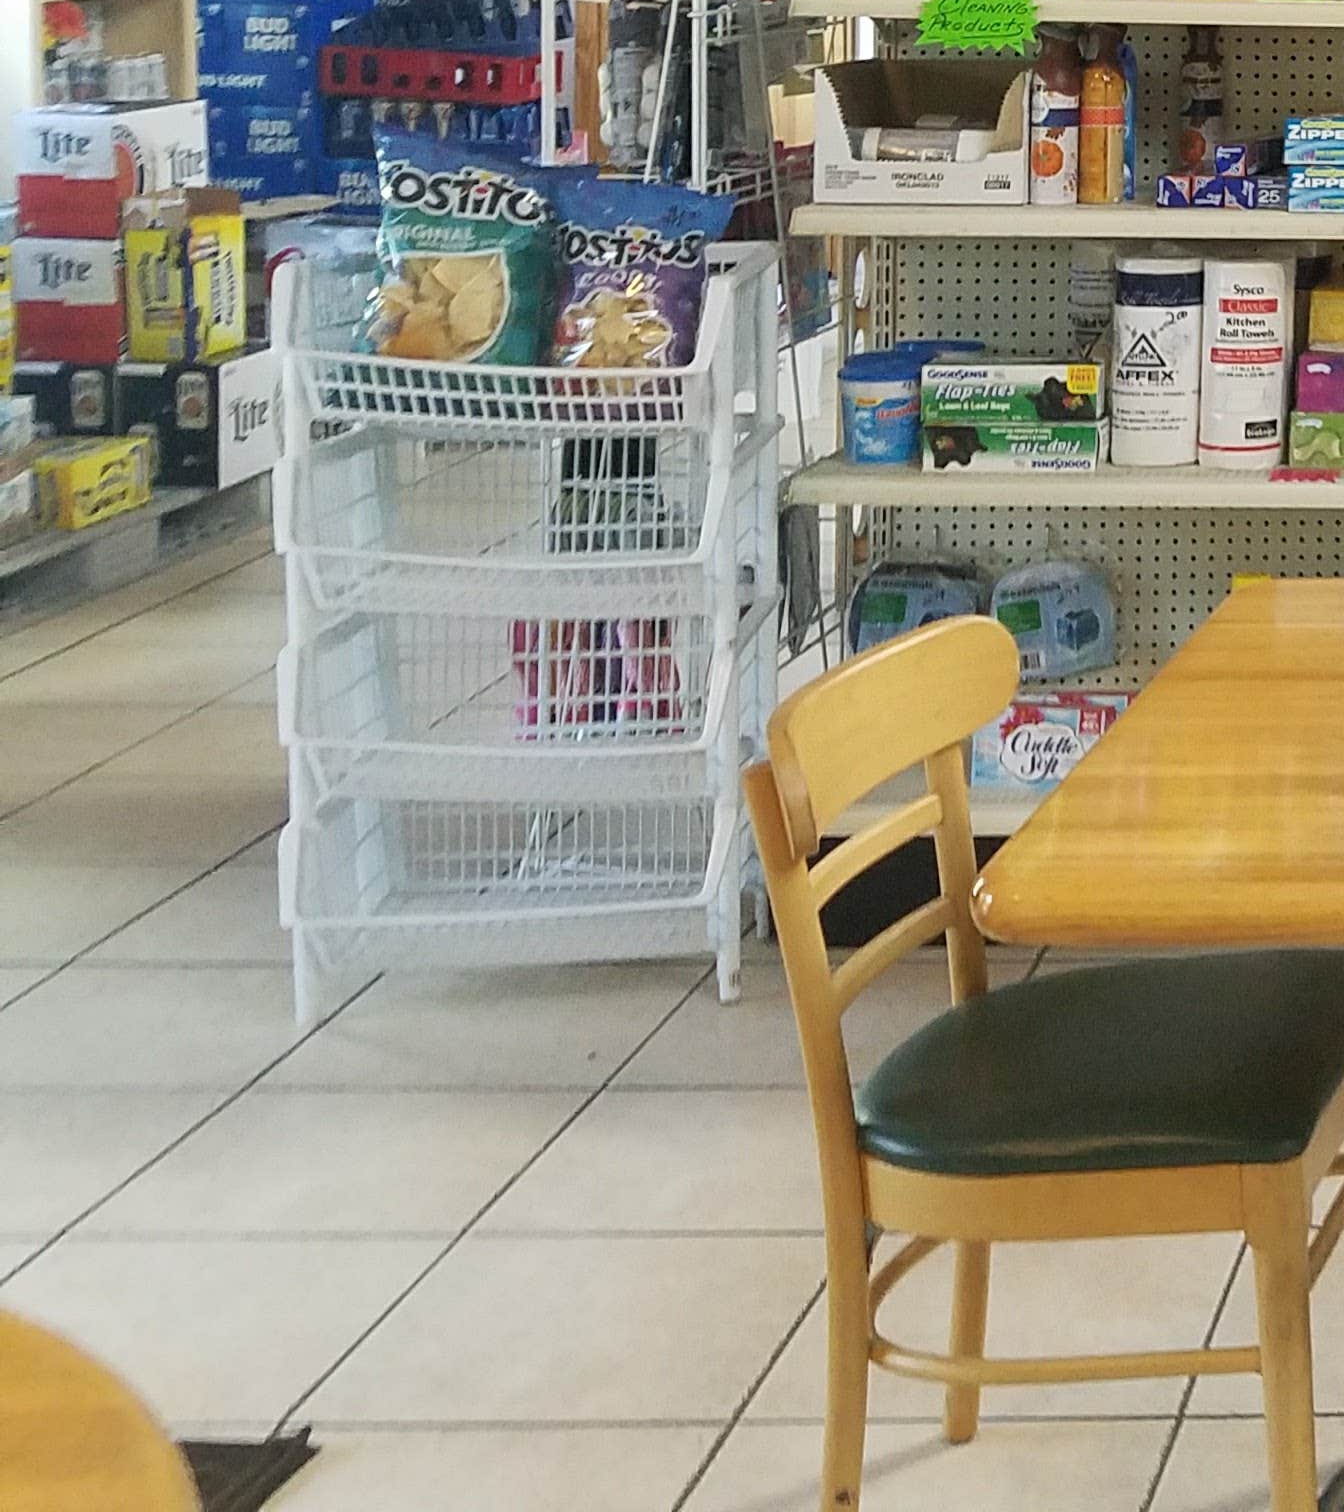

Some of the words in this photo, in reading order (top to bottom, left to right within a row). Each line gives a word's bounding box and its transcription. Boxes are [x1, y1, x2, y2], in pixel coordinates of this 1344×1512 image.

[246, 17, 289, 33] BUD
[930, 17, 1027, 37] Products
[38, 125, 92, 162] Lite
[892, 173, 944, 181] IRONCLAD
[1258, 189, 1280, 203] 25
[34, 252, 92, 289] Lite
[1234, 284, 1264, 296] Sysco
[1226, 318, 1266, 327] Kitchen
[1220, 329, 1238, 337] Roll
[1242, 329, 1274, 338] Towels
[228, 399, 269, 443] Lite
